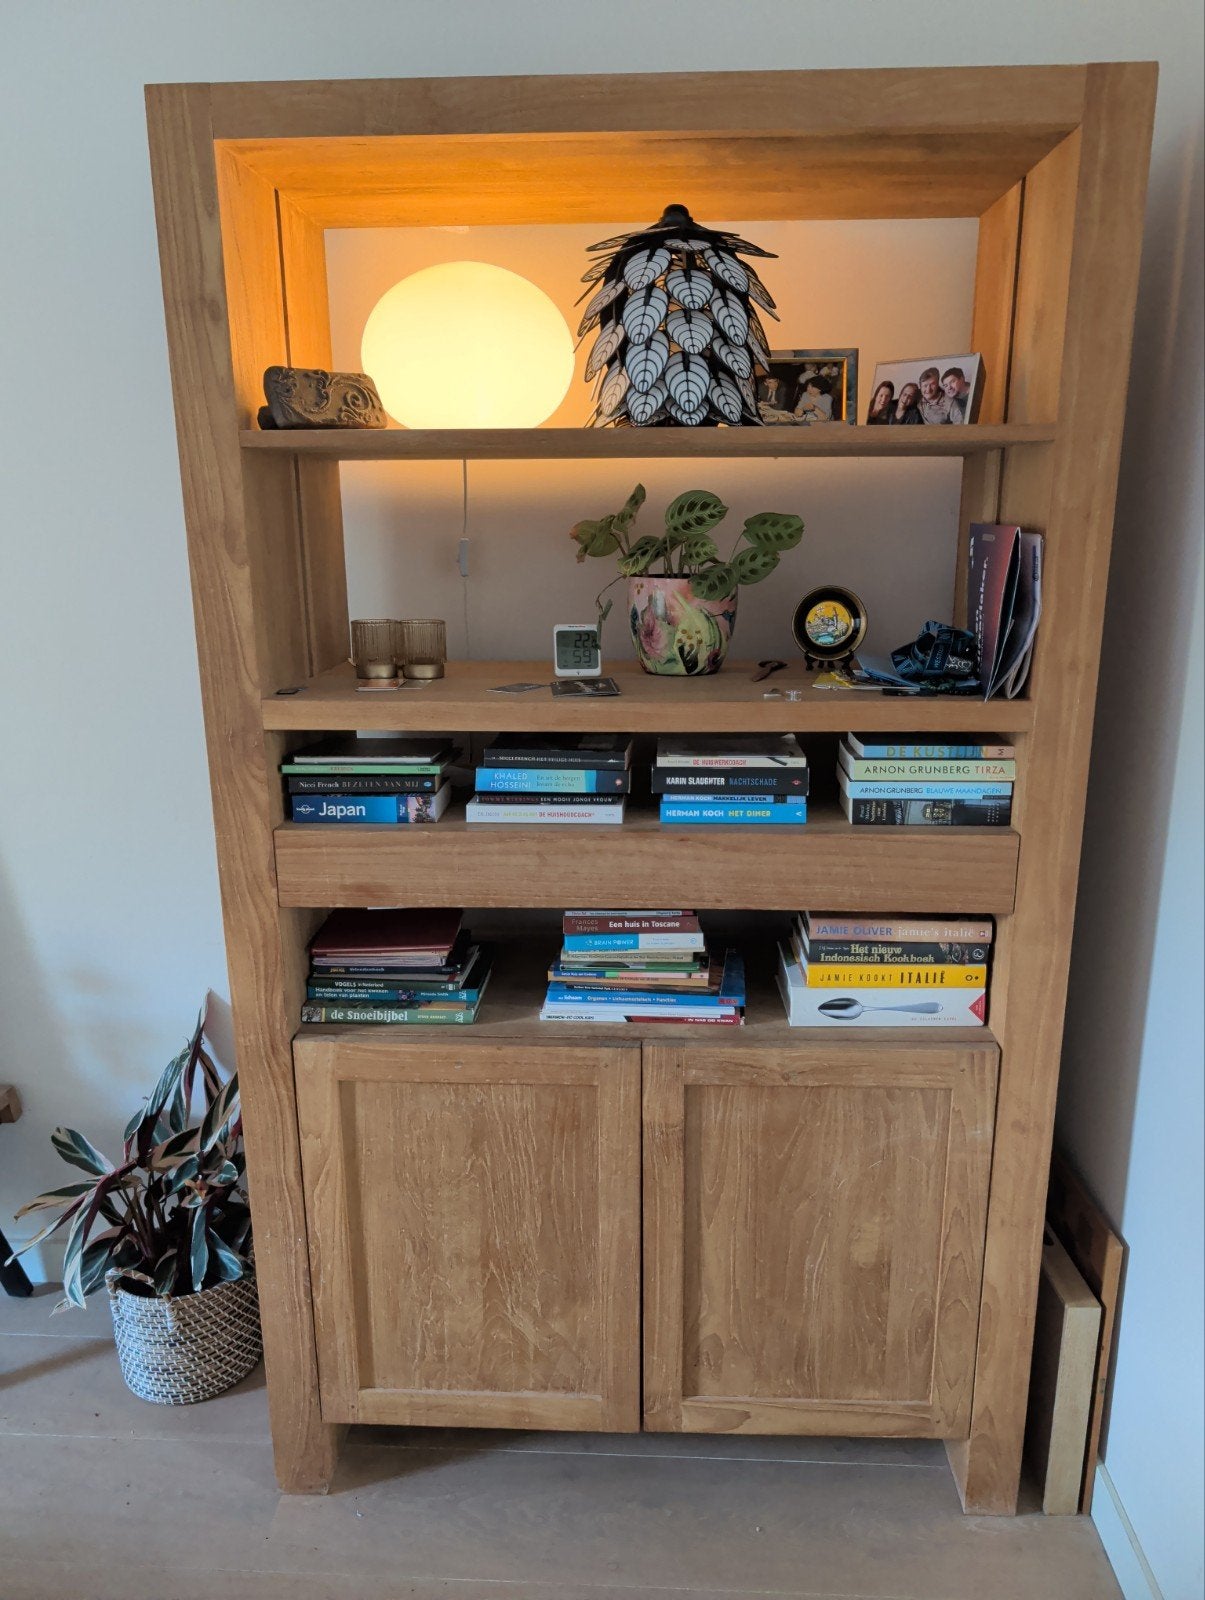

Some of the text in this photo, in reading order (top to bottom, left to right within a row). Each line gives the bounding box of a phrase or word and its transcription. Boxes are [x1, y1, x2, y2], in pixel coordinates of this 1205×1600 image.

[886, 746, 906, 756] DE
[864, 766, 1006, 774] ARNON GRUNBERG TIRZA
[666, 777, 778, 786] KARIN SLAUGHTER NACHTSCHADE
[318, 802, 366, 819] Japan
[816, 926, 849, 935] JAMIE
[853, 927, 892, 936] OLIVER
[898, 926, 939, 938] jamie's
[850, 944, 869, 954] Het
[820, 952, 935, 963] Indonesisch Kookboek
[900, 970, 945, 984] ITALIË
[330, 1010, 408, 1022] de Snoeibijbel
